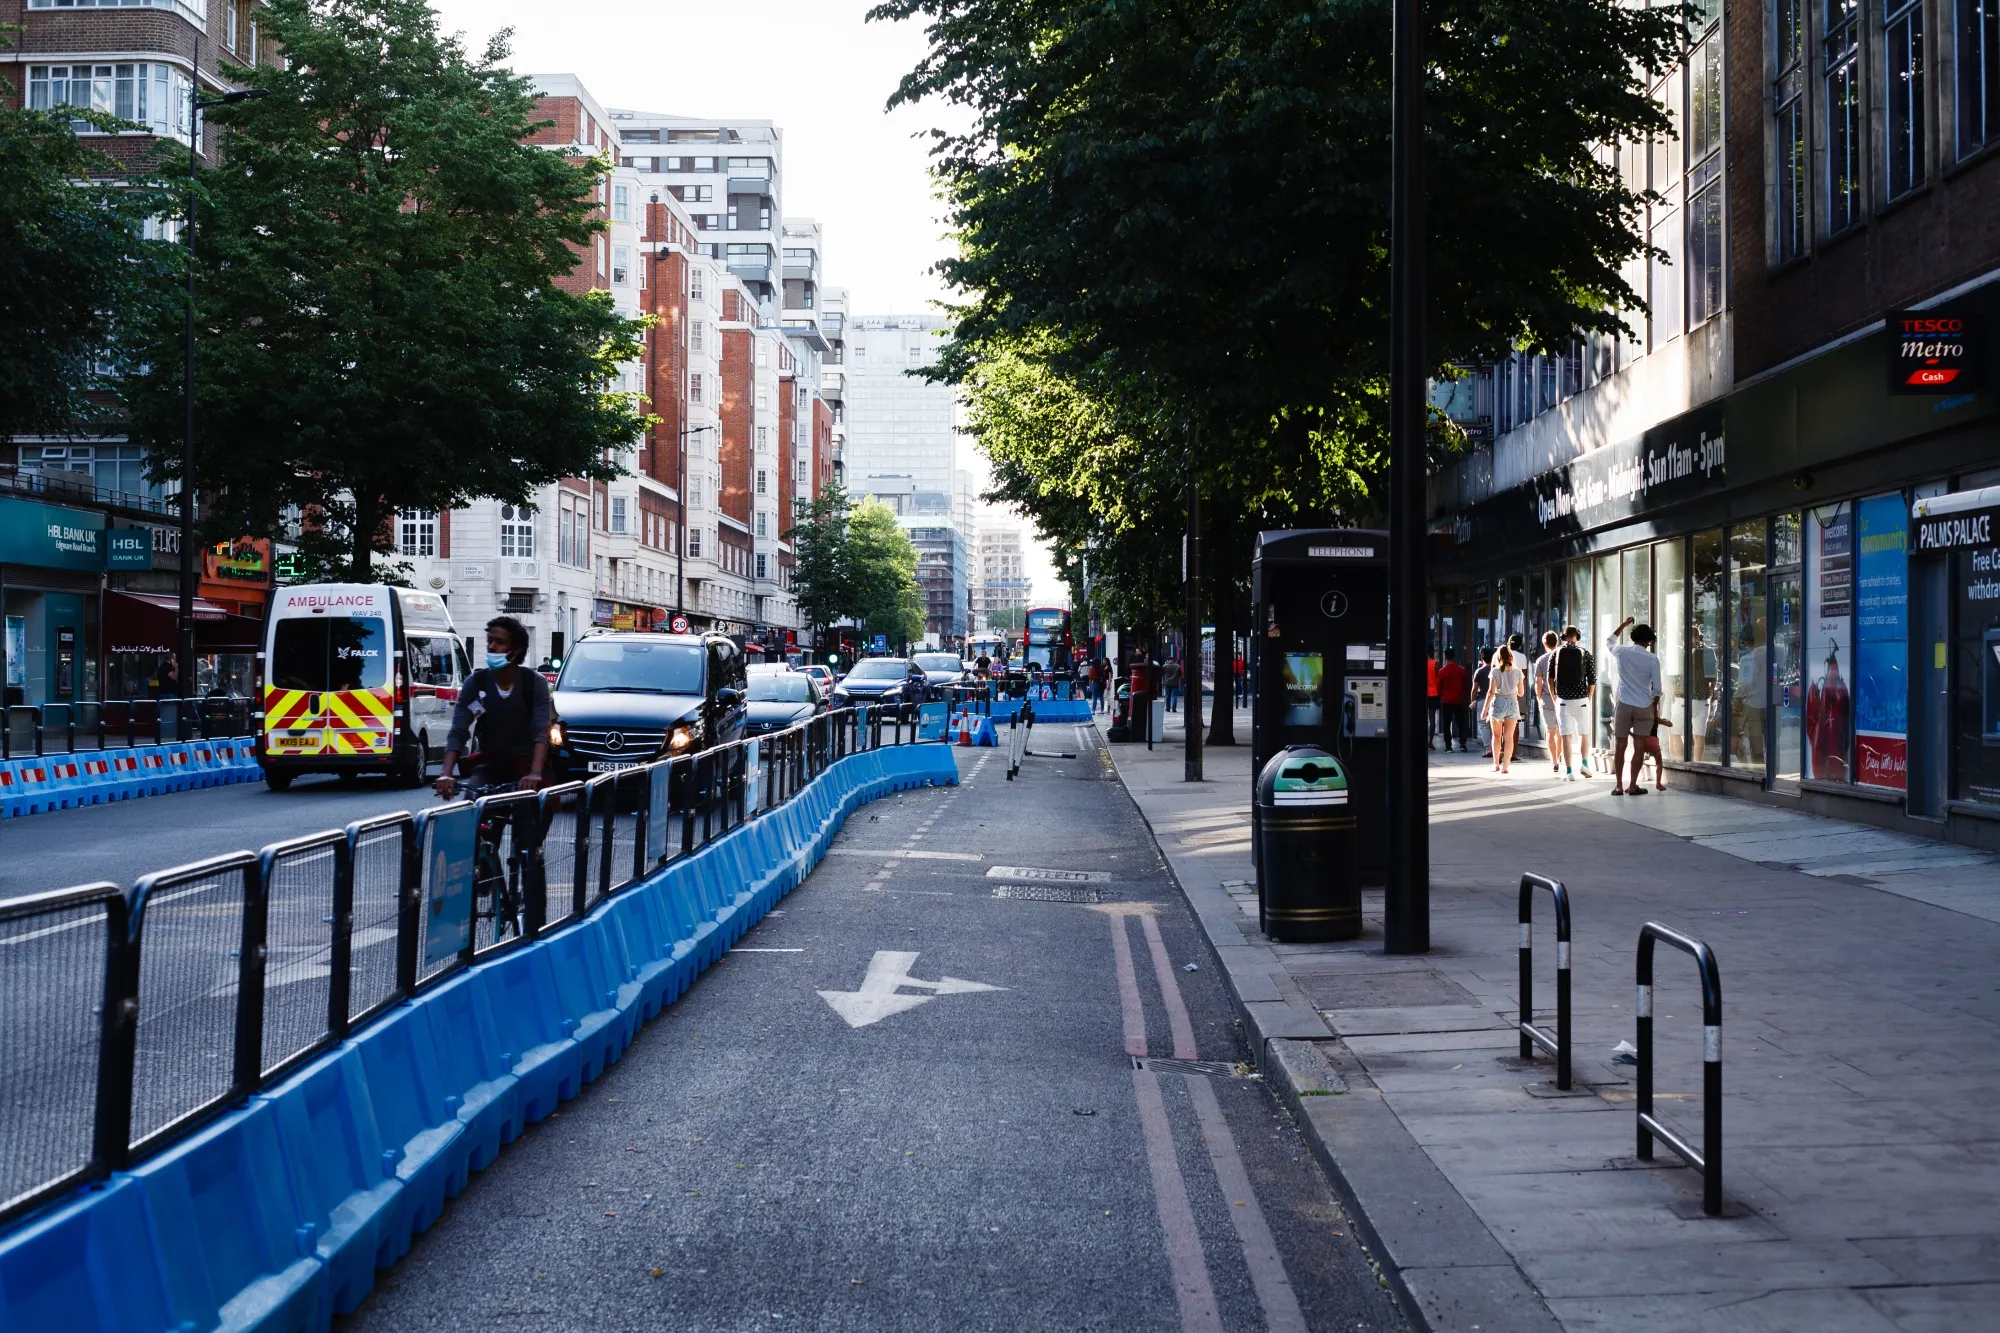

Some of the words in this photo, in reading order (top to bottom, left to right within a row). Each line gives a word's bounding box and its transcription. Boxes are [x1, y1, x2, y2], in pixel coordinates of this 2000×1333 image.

[1899, 319, 1963, 332] TESCO
[1900, 341, 1964, 358] Metro
[1922, 373, 1944, 381] Cash
[1538, 493, 1555, 529] Open
[1555, 486, 1571, 518] Mon
[1575, 479, 1587, 512] Sat
[1608, 456, 1648, 502] Midnight,
[1648, 450, 1667, 487] Sun
[1668, 442, 1692, 480] 11am
[1700, 432, 1725, 478] 5pm
[48, 524, 62, 539] HBL
[63, 526, 84, 542] BANK
[85, 530, 96, 543] UK
[1920, 520, 1952, 549] PALMS
[1953, 515, 1991, 546] PALACE
[112, 539, 144, 549] HBL
[1860, 524, 1907, 555] community
[73, 542, 82, 552] Road
[83, 543, 96, 553] Branch
[1312, 548, 1369, 556] TELEPHONE
[1973, 550, 1990, 572] Free
[1967, 577, 2000, 600] withdra
[287, 595, 374, 607] AMBULANCE
[111, 644, 138, 654] لبنانية
[139, 644, 170, 653] مأكولات
[350, 649, 379, 657] FALCK
[299, 738, 315, 746] EAJ
[592, 762, 616, 772] WG69
